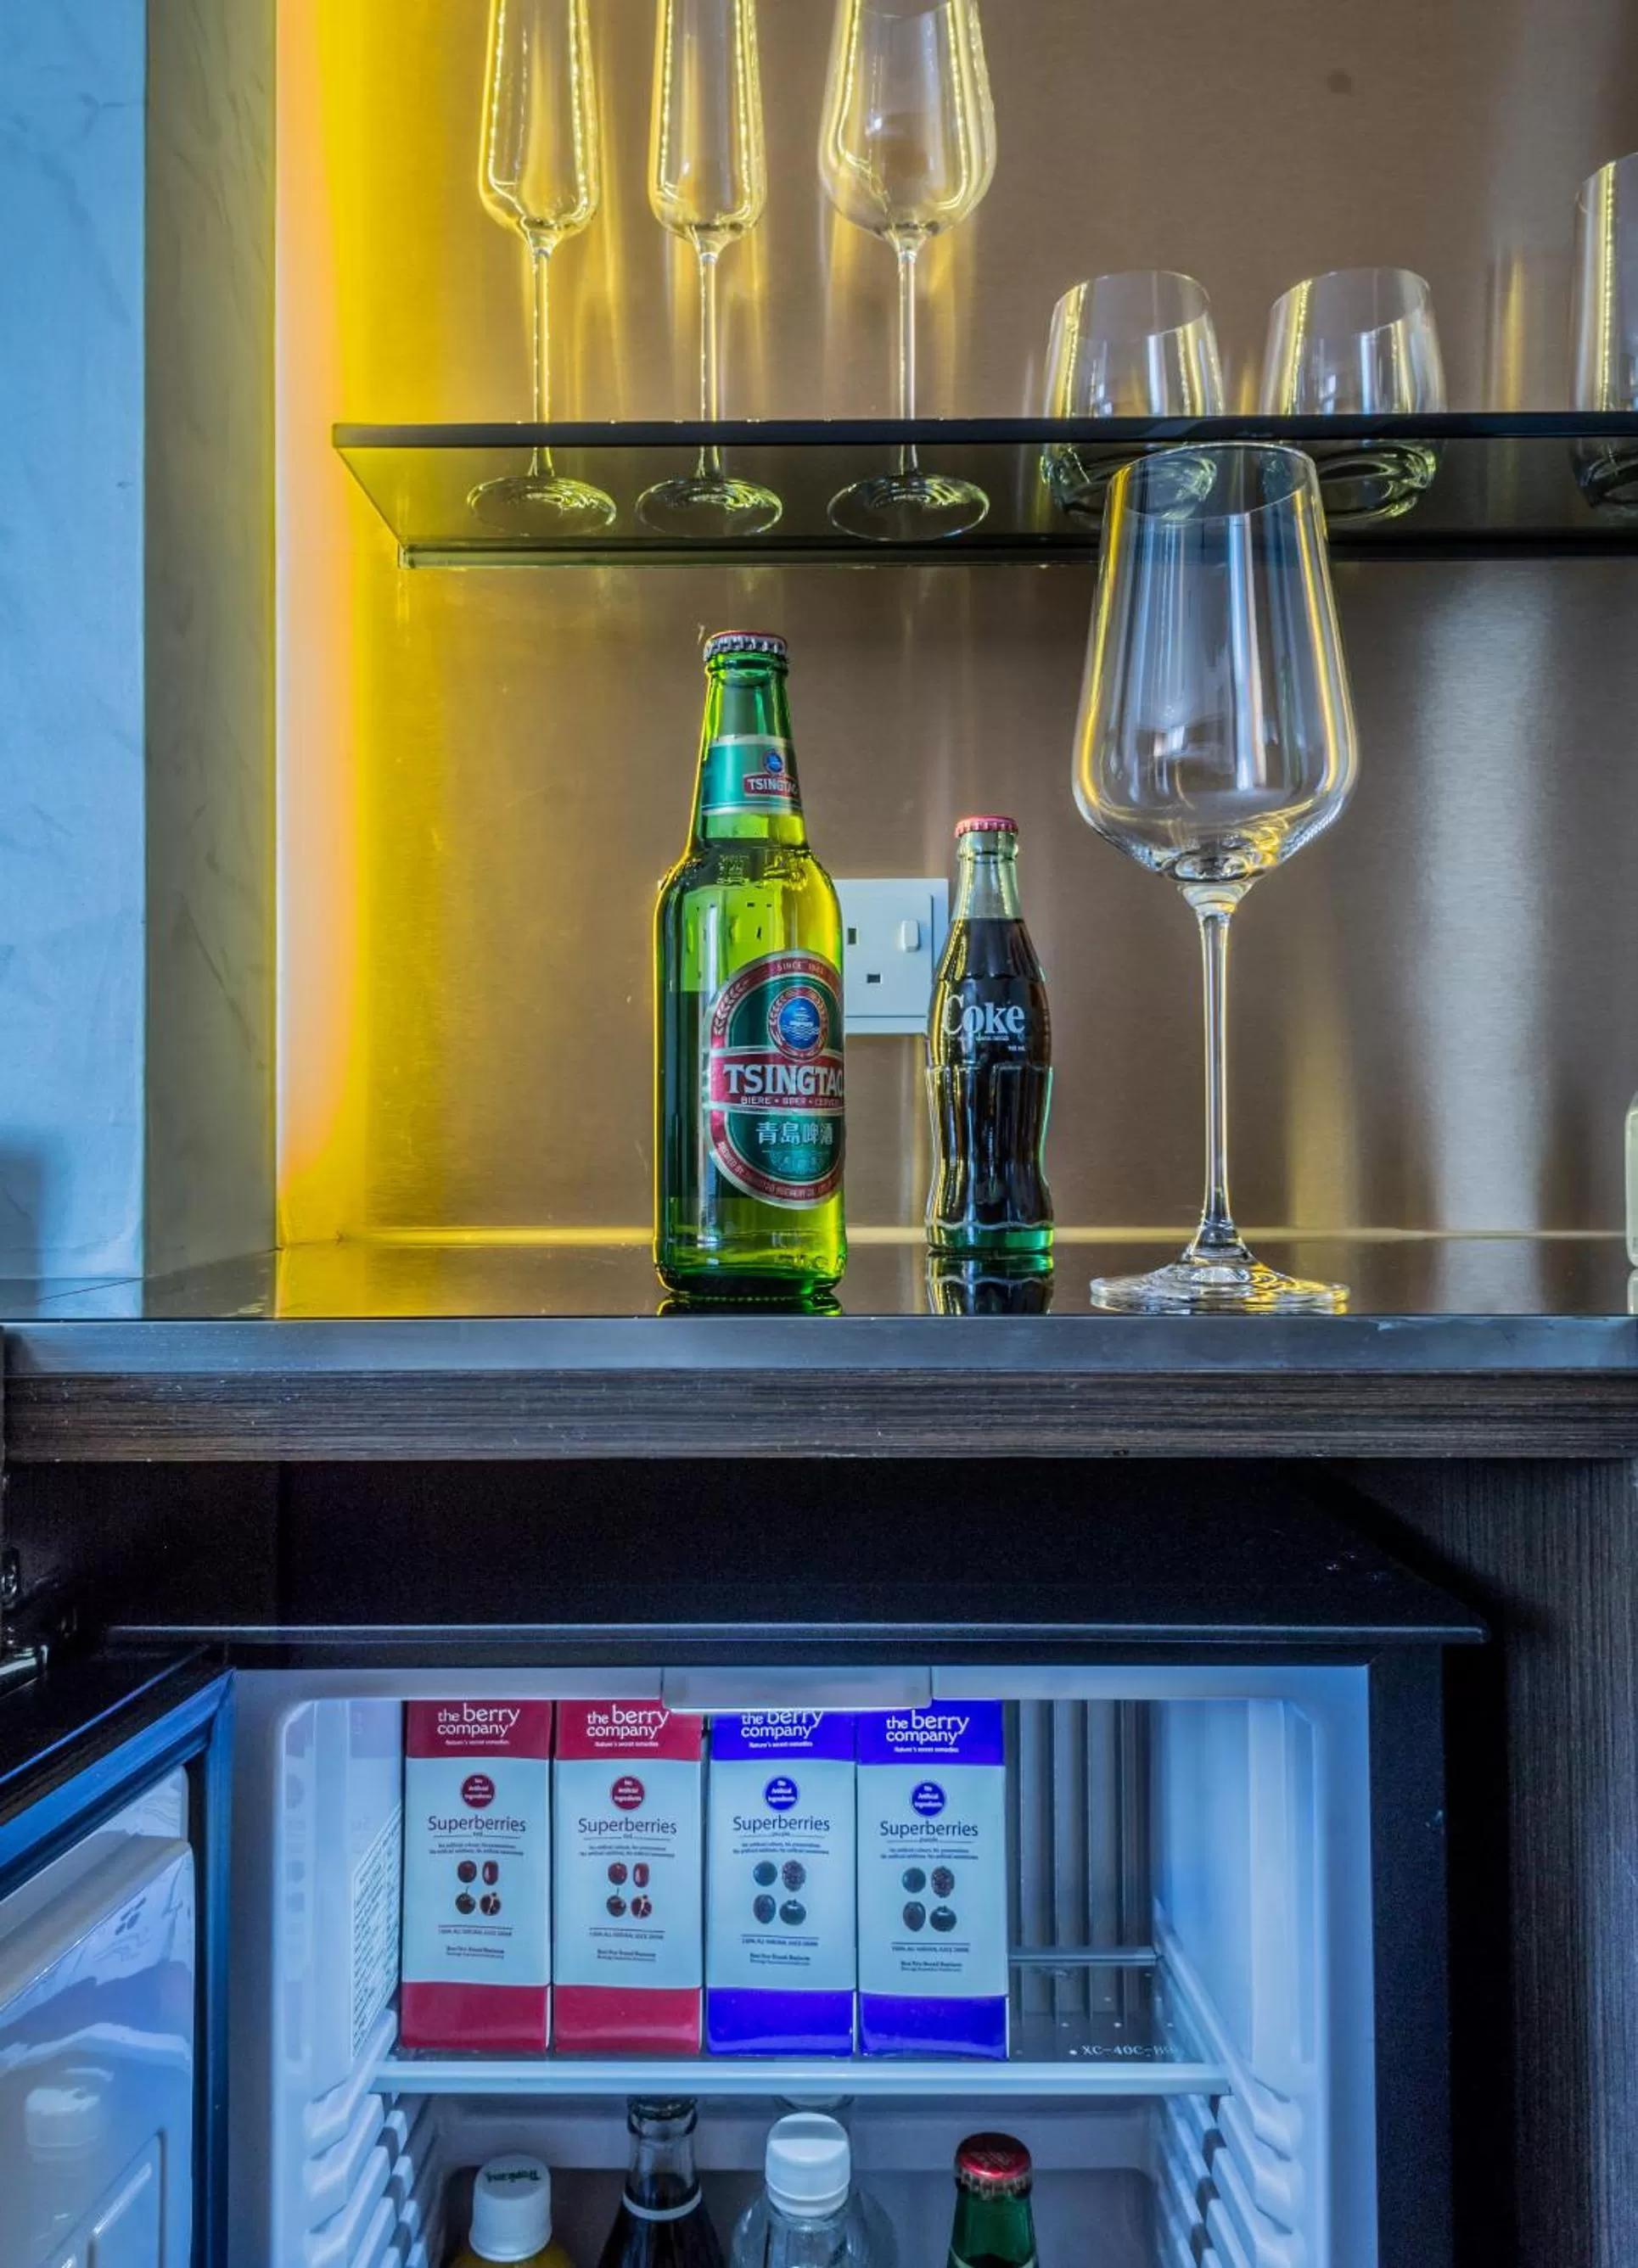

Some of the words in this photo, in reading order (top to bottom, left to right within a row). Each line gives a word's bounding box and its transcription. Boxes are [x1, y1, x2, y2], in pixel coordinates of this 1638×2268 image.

[777, 960, 802, 972] SINCE
[941, 994, 1026, 1035] Coke
[740, 1095, 772, 1106] BIERE
[437, 1708, 460, 1722] the
[463, 1702, 520, 1727] berry
[587, 1711, 609, 1725] the
[612, 1704, 670, 1728] berry
[741, 1712, 764, 1725] the
[886, 1715, 909, 1729] the
[911, 1709, 969, 1735] berry
[437, 1724, 509, 1738] company
[586, 1726, 658, 1739] company
[741, 1726, 812, 1740] company
[885, 1730, 958, 1745] company
[427, 1815, 526, 1833] Superberries
[578, 1817, 677, 1835] Superberries
[732, 1814, 830, 1833] Superberries
[879, 1820, 979, 1838] Superberries
